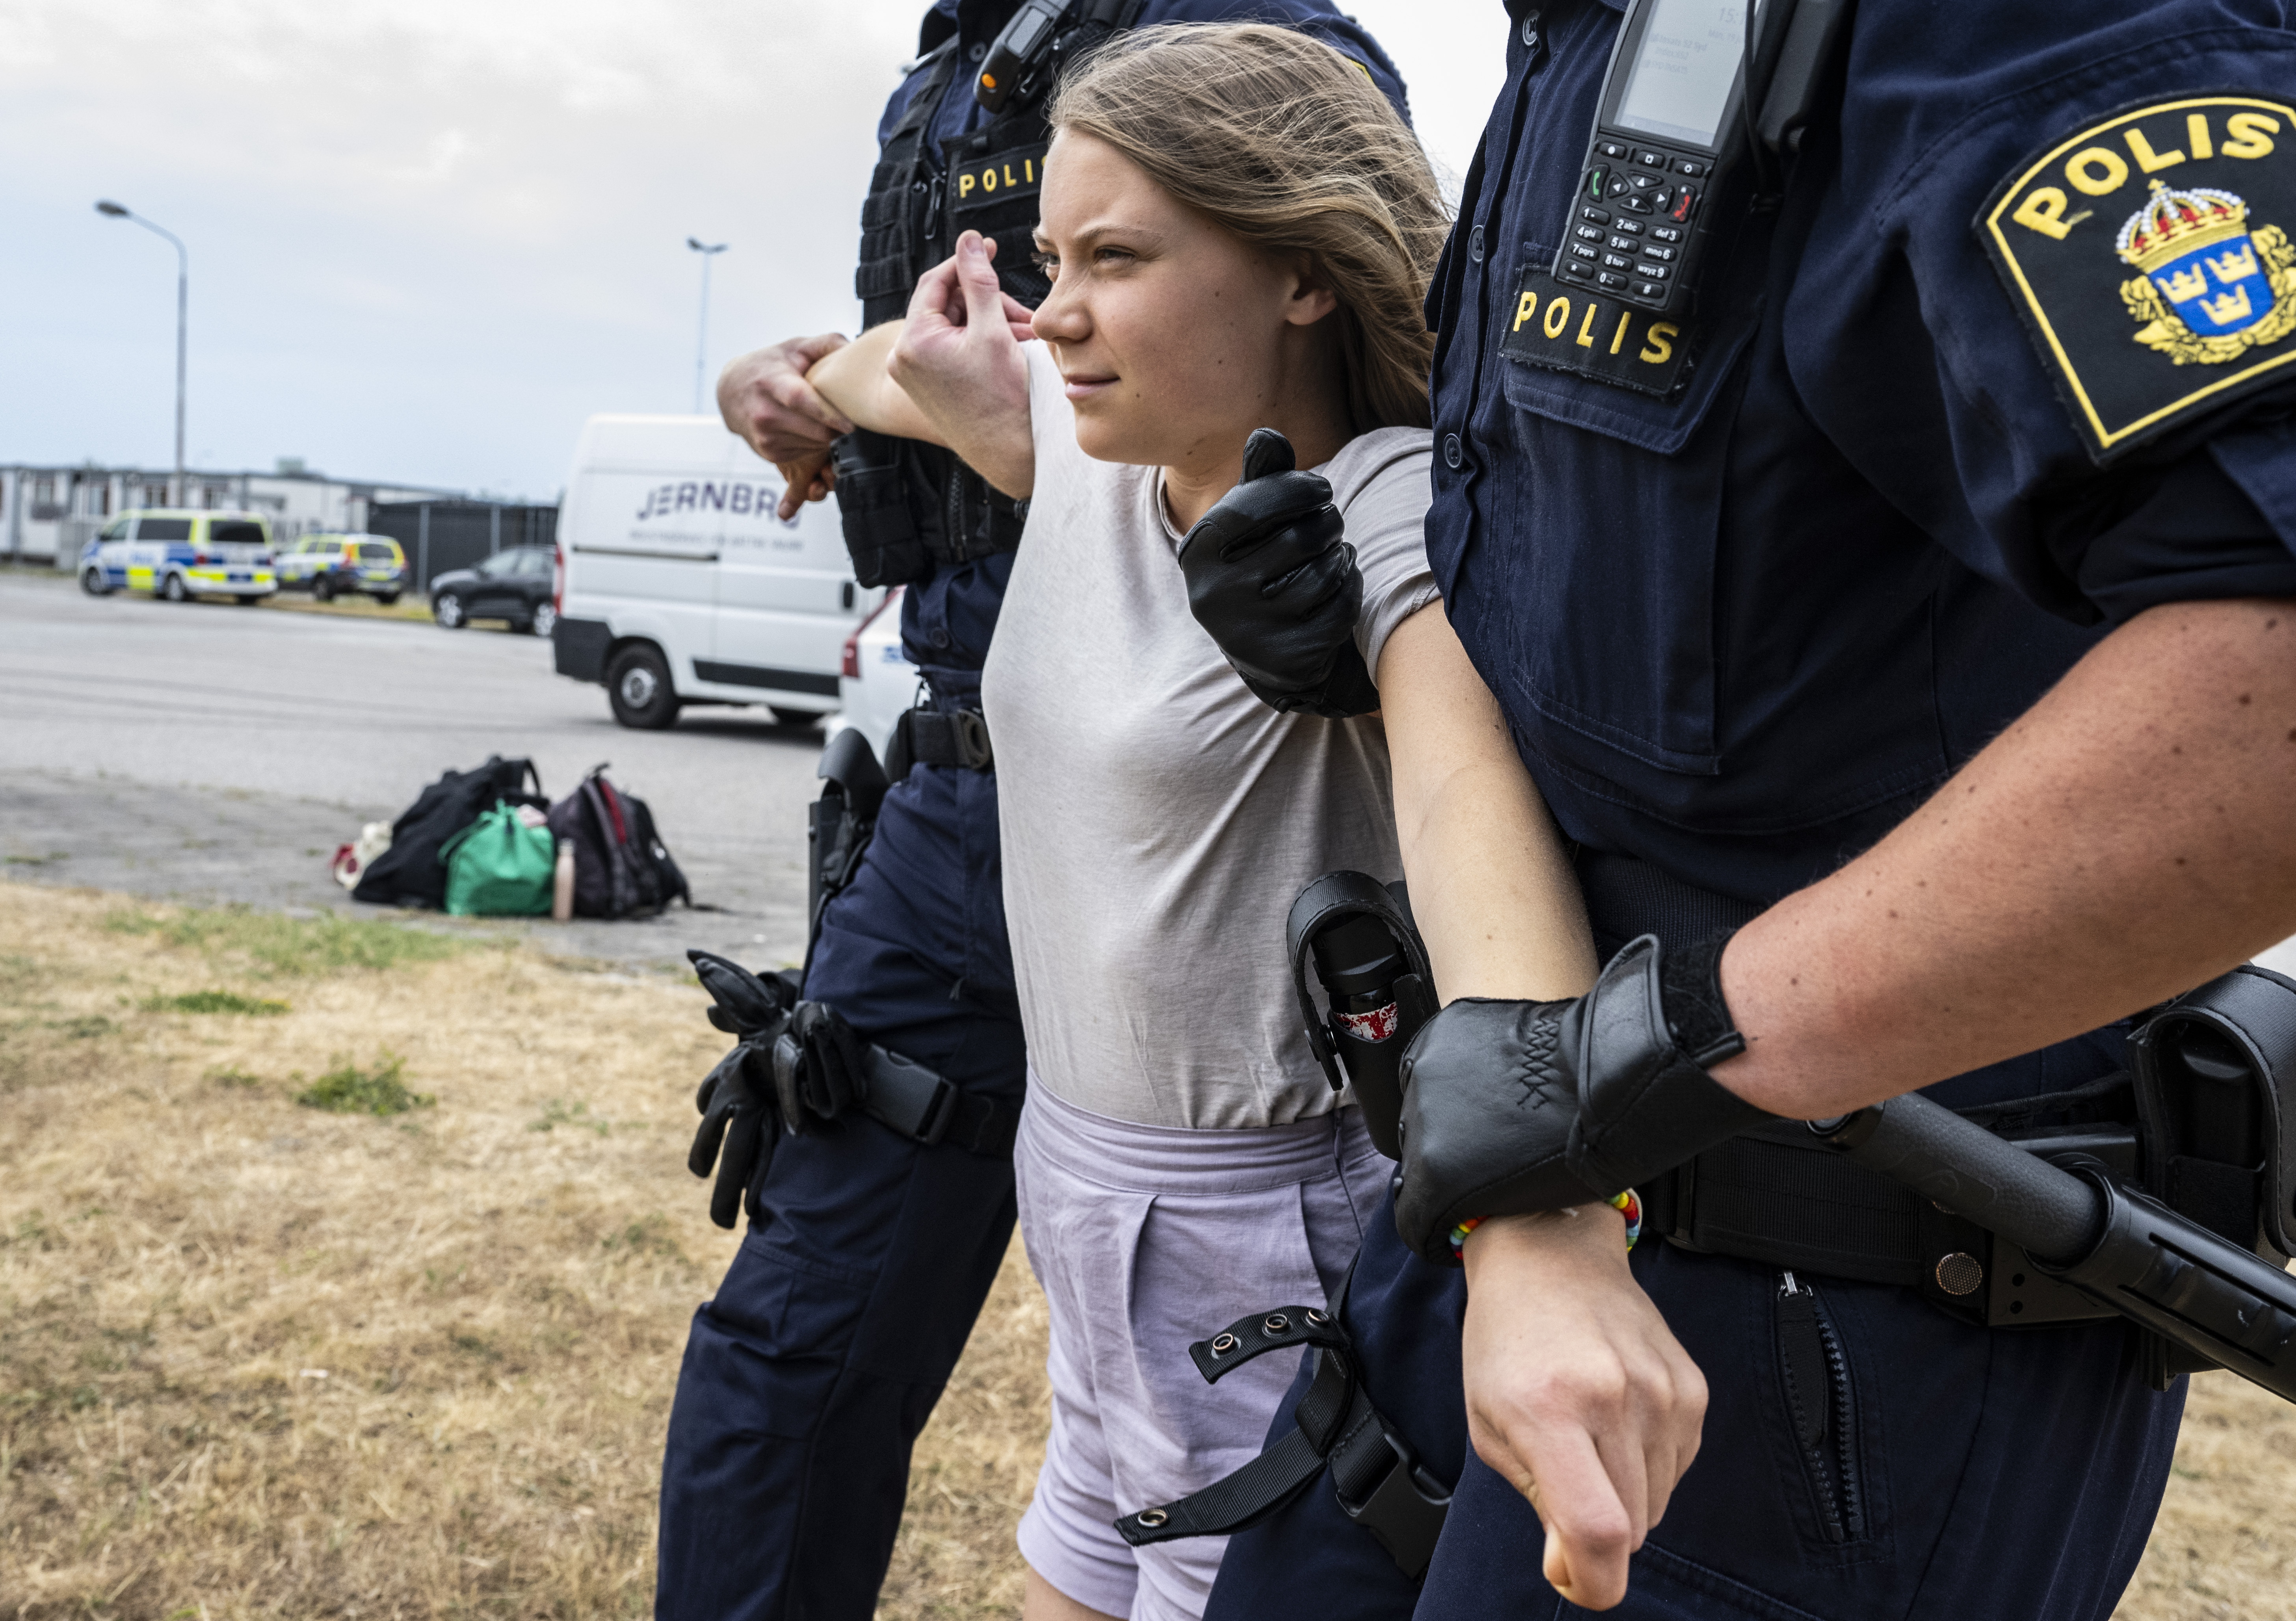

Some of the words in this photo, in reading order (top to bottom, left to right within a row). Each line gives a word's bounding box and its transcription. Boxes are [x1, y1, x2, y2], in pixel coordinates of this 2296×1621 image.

[959, 155, 1046, 198] POLI
[2012, 113, 2280, 240] POLIS
[1513, 291, 1680, 364] POLIS
[636, 481, 800, 529] JERNBR
